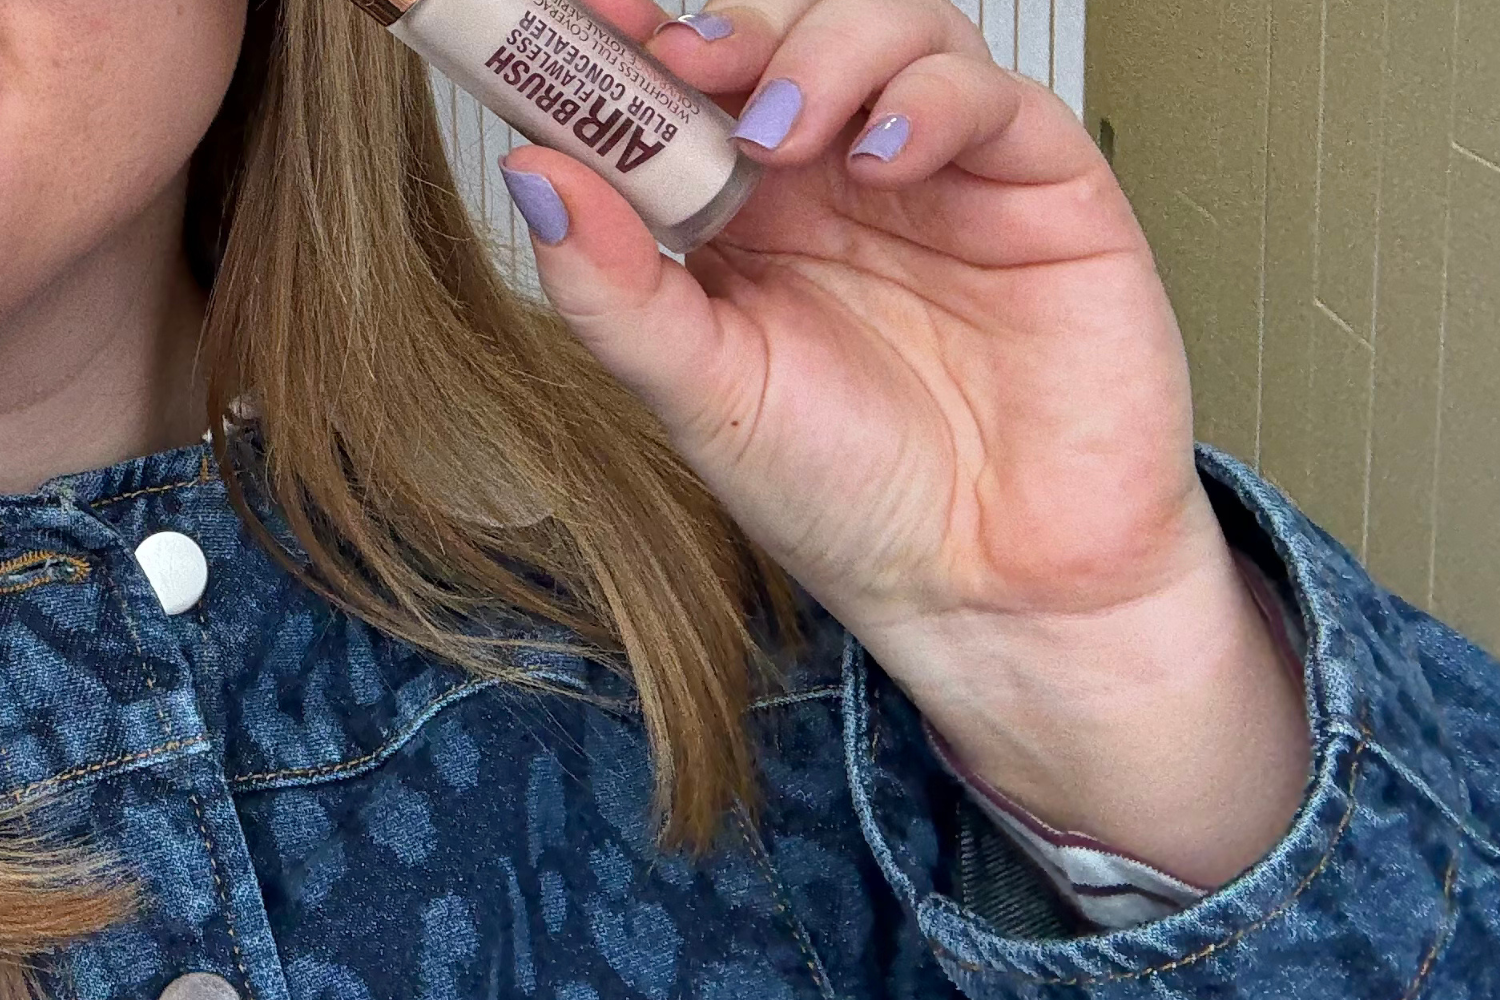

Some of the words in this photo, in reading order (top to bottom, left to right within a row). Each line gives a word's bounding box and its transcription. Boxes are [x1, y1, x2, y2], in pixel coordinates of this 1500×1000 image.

[519, 10, 626, 101] CONCEALER
[585, 19, 626, 57] TOTALE
[591, 39, 618, 65] FULL
[506, 29, 595, 103] FLAWLESS
[618, 61, 690, 124] WEIGHTLESS
[627, 95, 678, 143] BLUR
